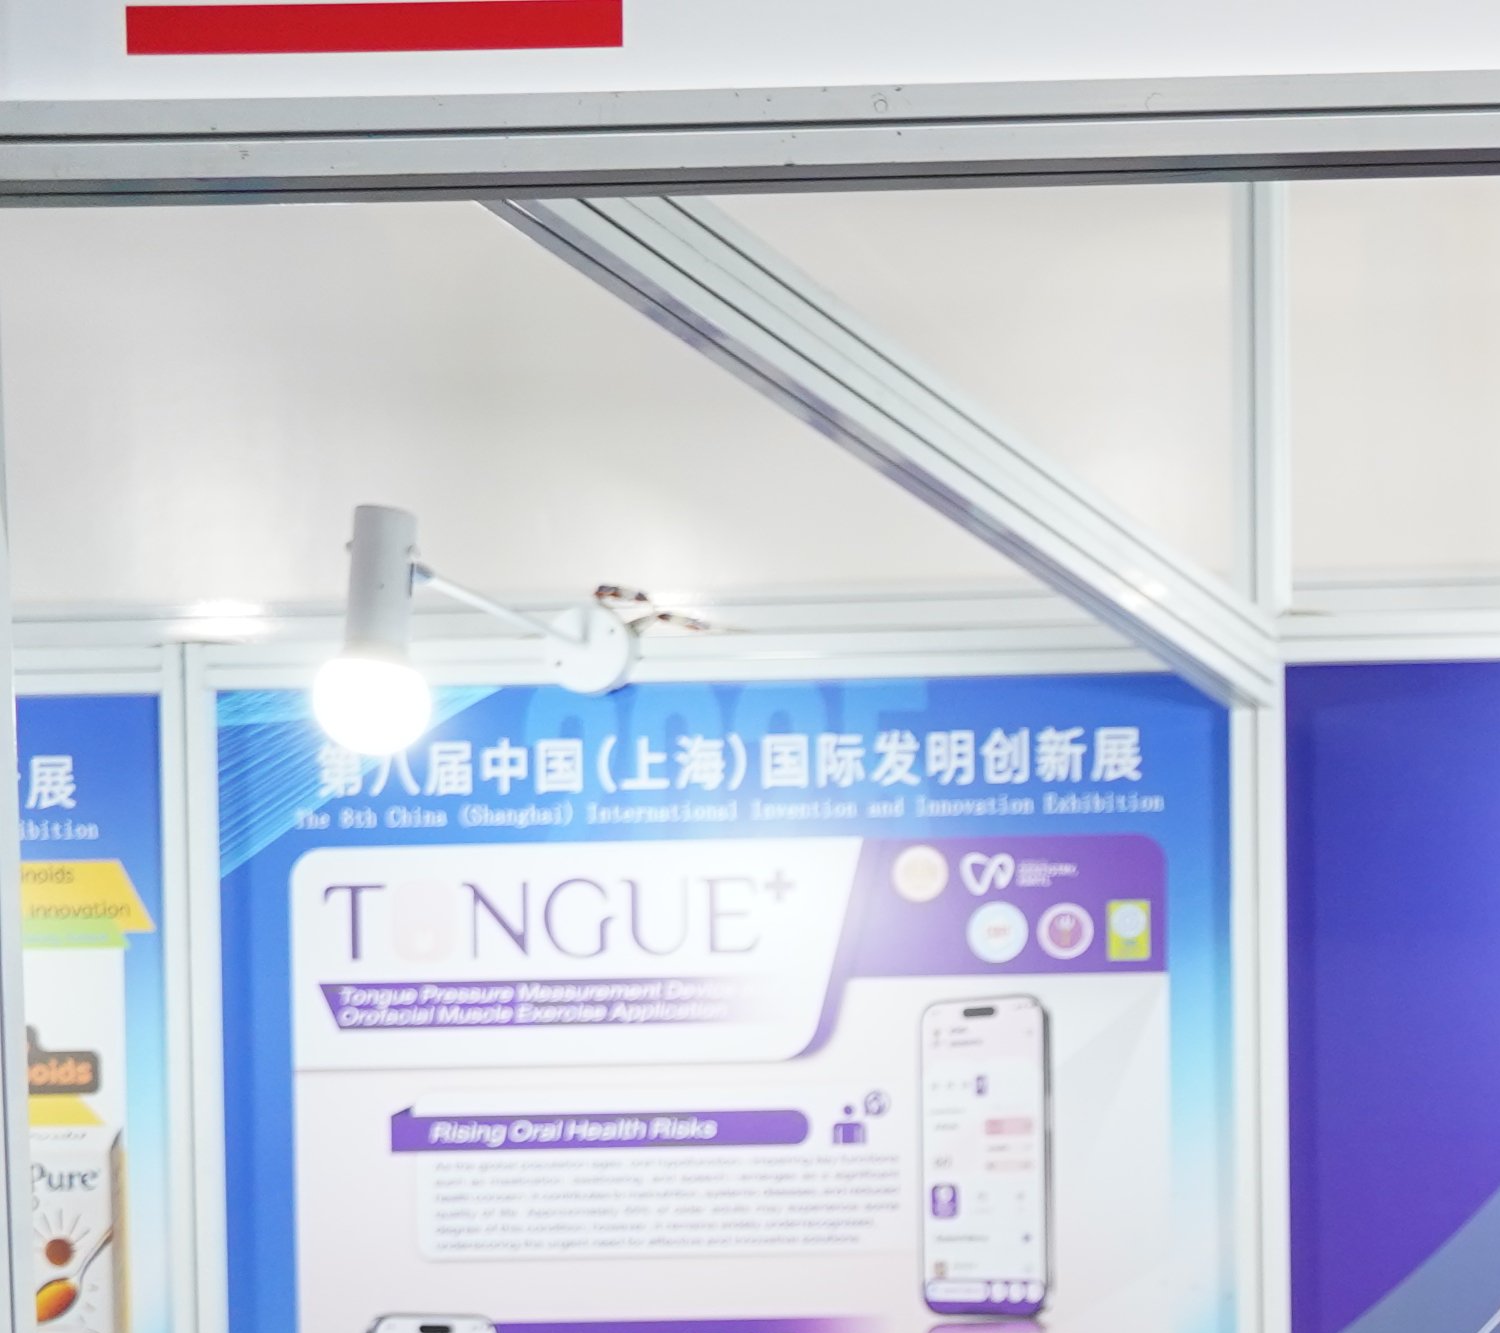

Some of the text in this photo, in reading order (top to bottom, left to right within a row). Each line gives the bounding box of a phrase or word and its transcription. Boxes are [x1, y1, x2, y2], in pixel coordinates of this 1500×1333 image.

[428, 1118, 719, 1149] Rising Oral Health Risks
